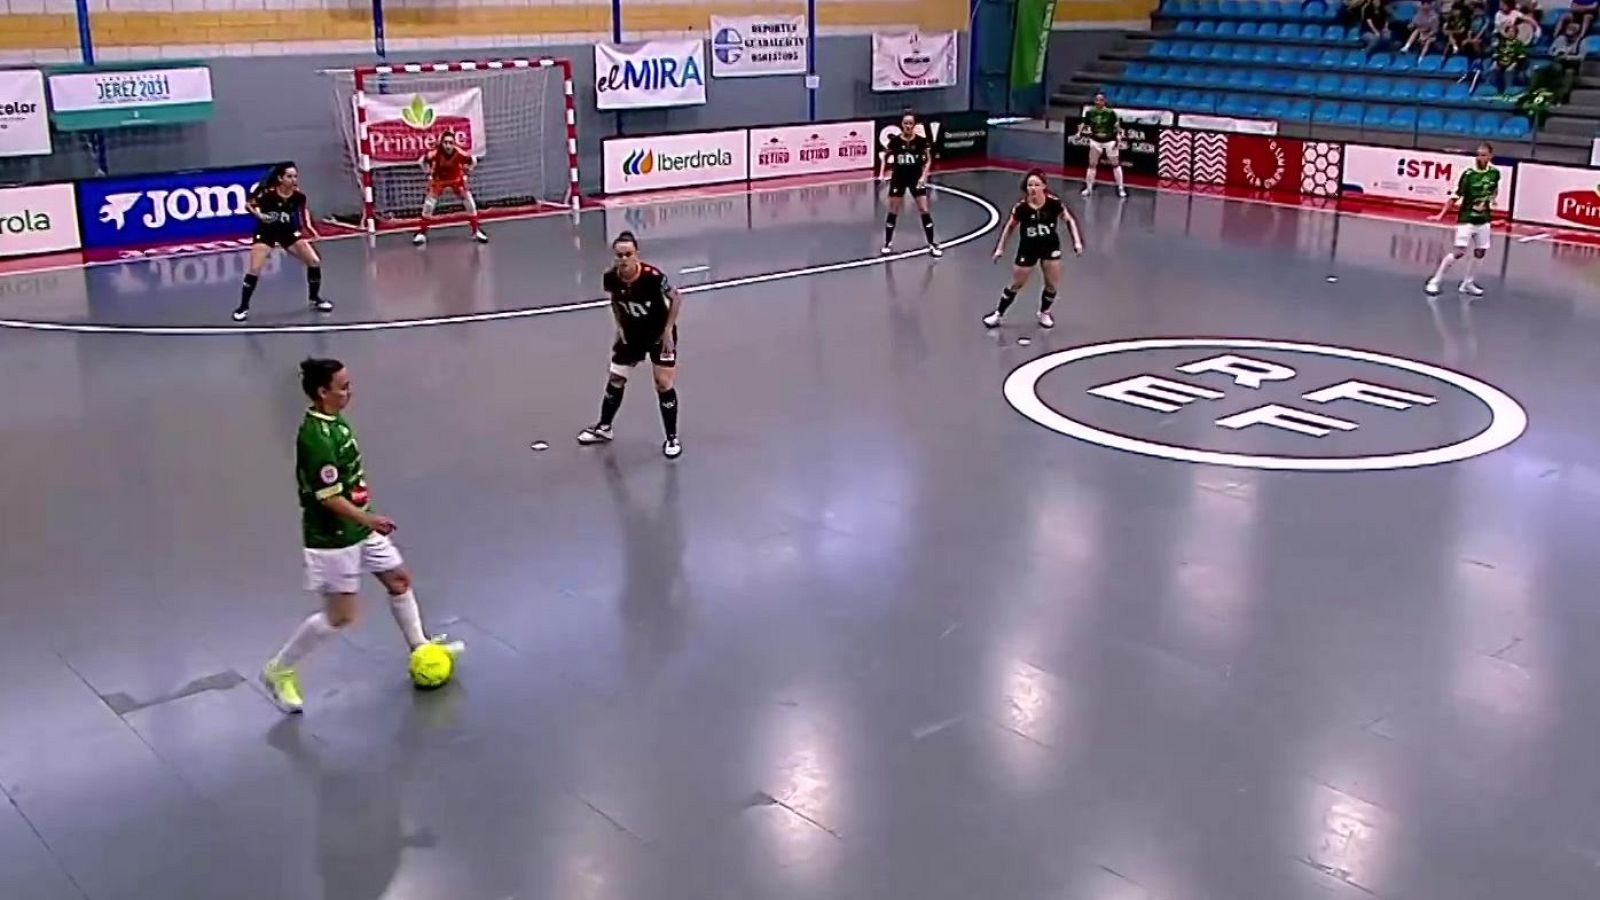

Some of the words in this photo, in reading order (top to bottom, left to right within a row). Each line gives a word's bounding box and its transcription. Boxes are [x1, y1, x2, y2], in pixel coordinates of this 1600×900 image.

[96, 80, 138, 99] JEREZ
[139, 73, 170, 97] 2031
[758, 150, 790, 166] RETIRO
[799, 146, 830, 161] RETIRO
[838, 143, 868, 158] RETIRO
[657, 148, 733, 172] Iberdrola
